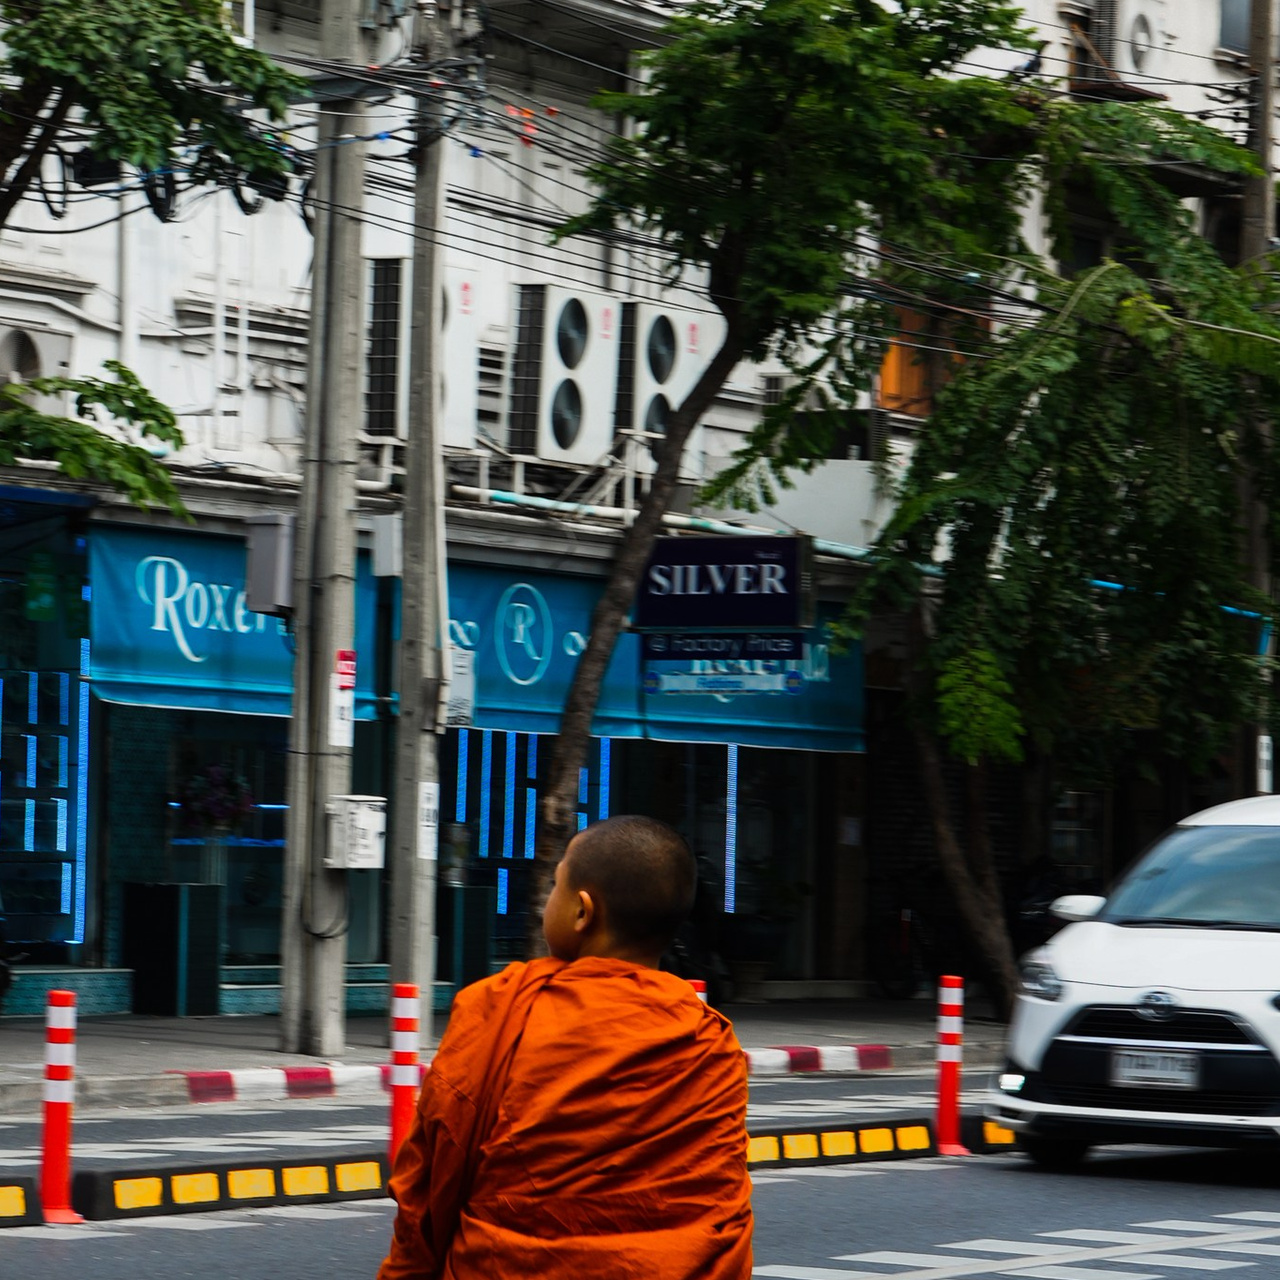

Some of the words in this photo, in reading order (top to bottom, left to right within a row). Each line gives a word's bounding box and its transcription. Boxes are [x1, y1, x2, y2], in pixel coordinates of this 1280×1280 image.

[648, 564, 789, 595] SILVER
[671, 634, 744, 658] Factory
[746, 634, 795, 652] Price
